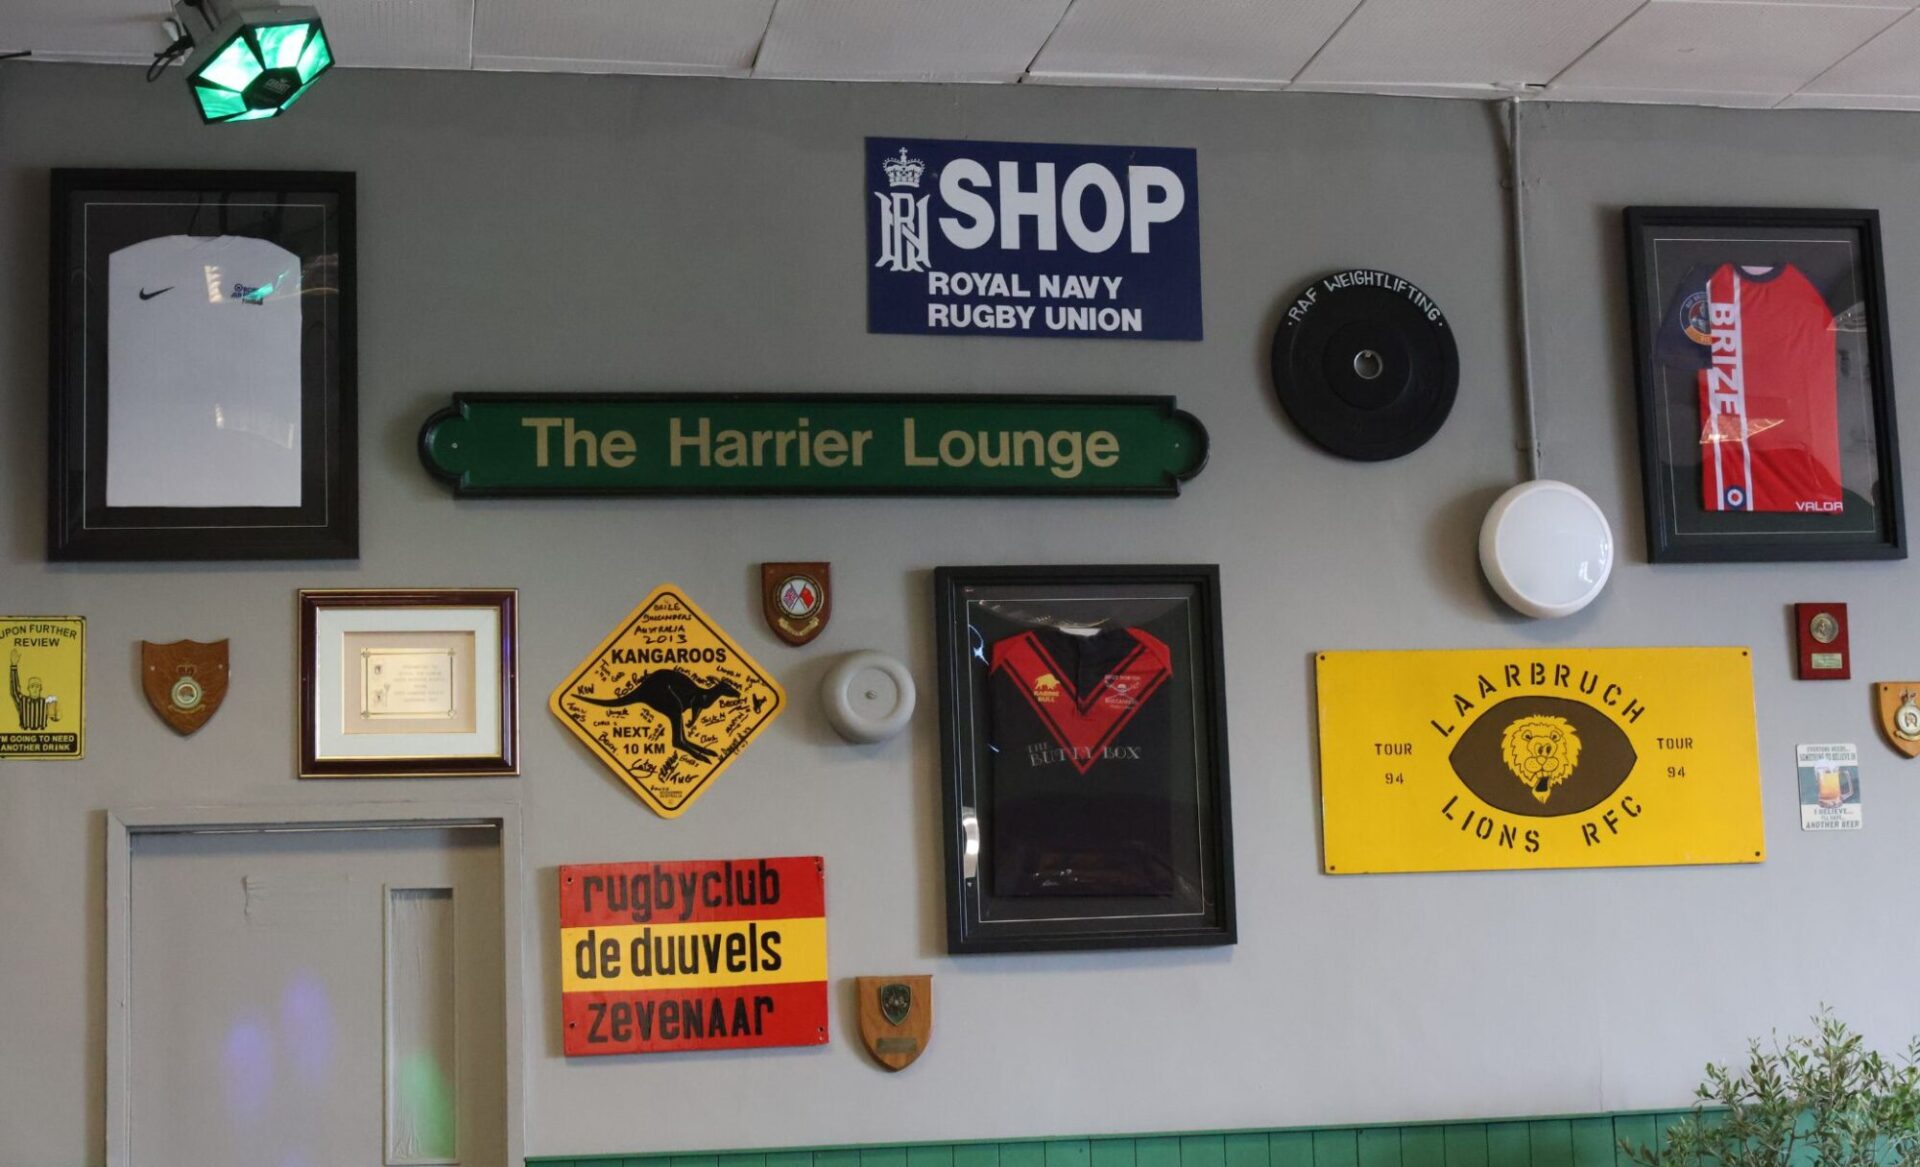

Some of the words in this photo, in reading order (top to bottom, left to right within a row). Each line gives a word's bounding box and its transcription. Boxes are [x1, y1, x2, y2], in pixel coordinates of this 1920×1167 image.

[938, 157, 1186, 254] SHOP
[927, 271, 1031, 298] ROYAL
[1039, 274, 1123, 300] NAVY
[1288, 287, 1320, 322] RAF
[1323, 270, 1441, 322] WEIGHTLIFTING
[927, 303, 1036, 329] RUGBY
[1045, 306, 1142, 332] UNION
[1711, 302, 1741, 418] BRIZE
[521, 417, 638, 467] The
[669, 417, 872, 467] Harrier
[903, 417, 1120, 479] Lounge
[29, 624, 78, 640] FURTHER
[643, 634, 688, 645] 2013
[14, 637, 61, 647] REVIEW
[611, 647, 727, 664] KANGAROOS
[1429, 662, 1646, 738] LAARBRUCH
[10, 735, 37, 743] GOING
[52, 735, 75, 743] NEED
[612, 727, 651, 738] NEXT
[1, 743, 41, 752] ANOTHER
[42, 743, 70, 751] DRINK
[623, 743, 639, 755] 10
[643, 743, 666, 755] KM
[1374, 743, 1413, 756] TOUR
[1656, 736, 1694, 750] TOUR
[1104, 746, 1142, 760] BOX
[1385, 772, 1404, 785] 94
[1667, 766, 1686, 779] 94
[1441, 795, 1540, 853] LIONS
[1581, 795, 1642, 847] RFC
[583, 859, 781, 923] rugbyclub
[575, 929, 621, 979] de
[630, 922, 782, 977] duuvels
